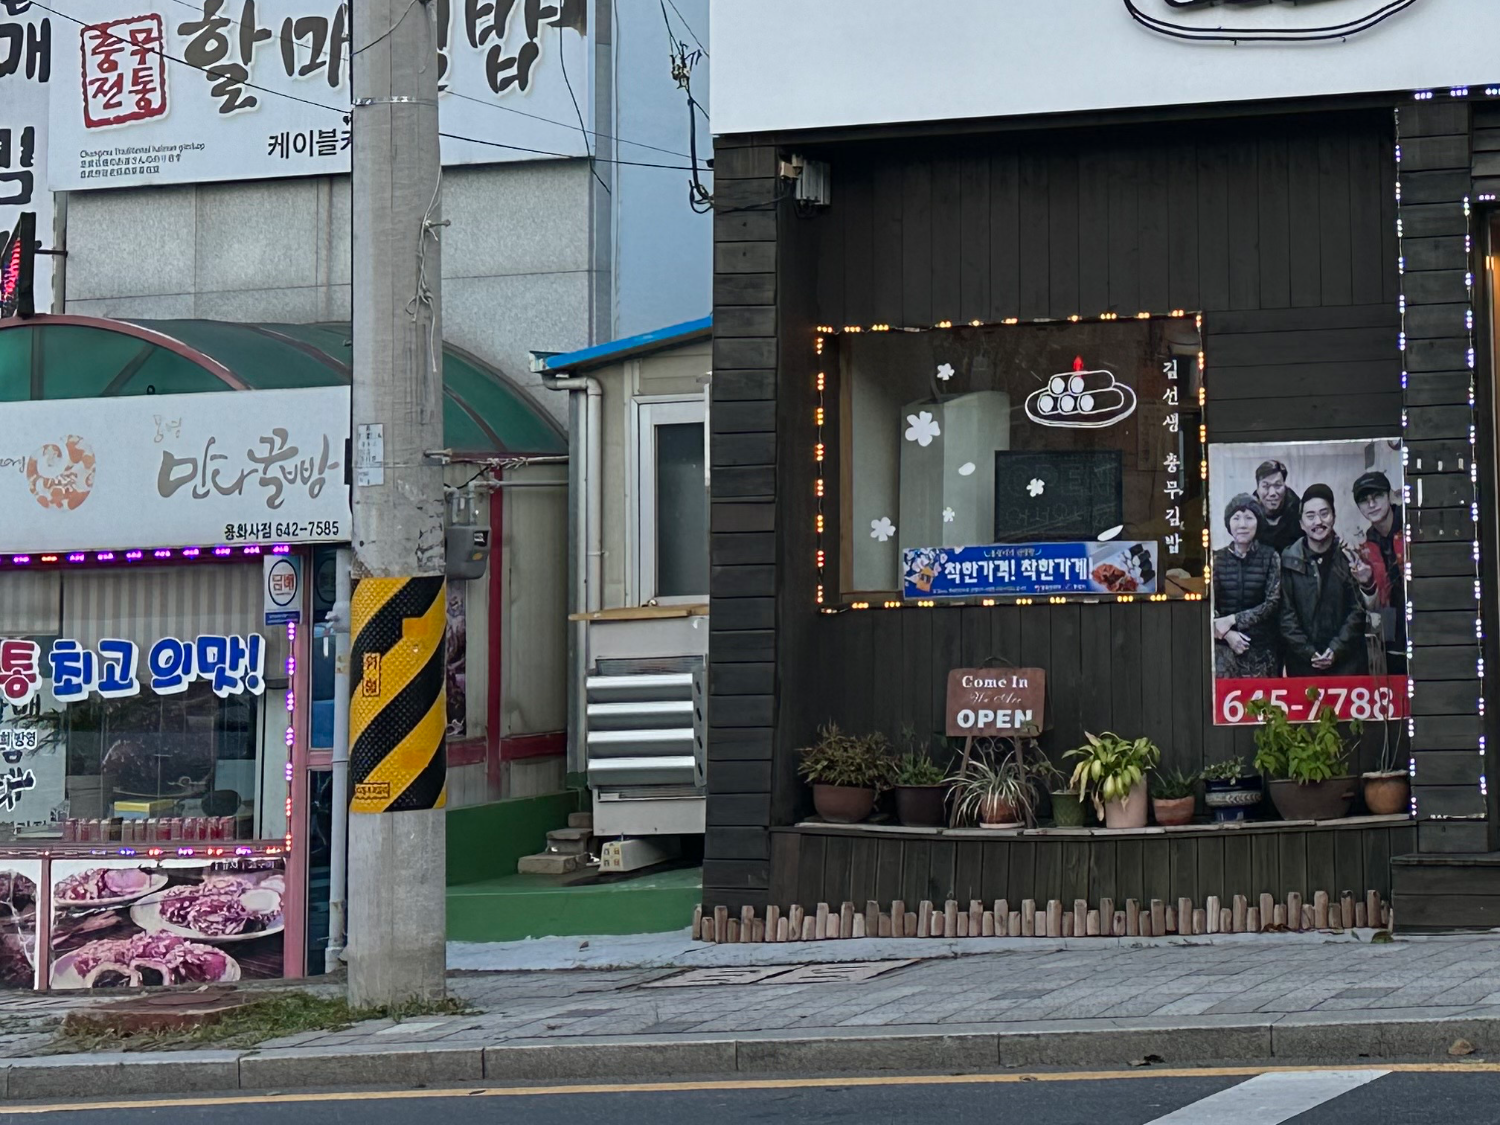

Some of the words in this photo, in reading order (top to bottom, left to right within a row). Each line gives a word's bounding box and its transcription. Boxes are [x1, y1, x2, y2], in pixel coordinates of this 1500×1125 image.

[1162, 359, 1179, 433] 김선생
[1163, 452, 1183, 555] 충무김밥
[275, 520, 340, 538] 642-7585
[962, 675, 1007, 689] Come
[1012, 675, 1028, 689] In
[957, 708, 1033, 729] OPEN
